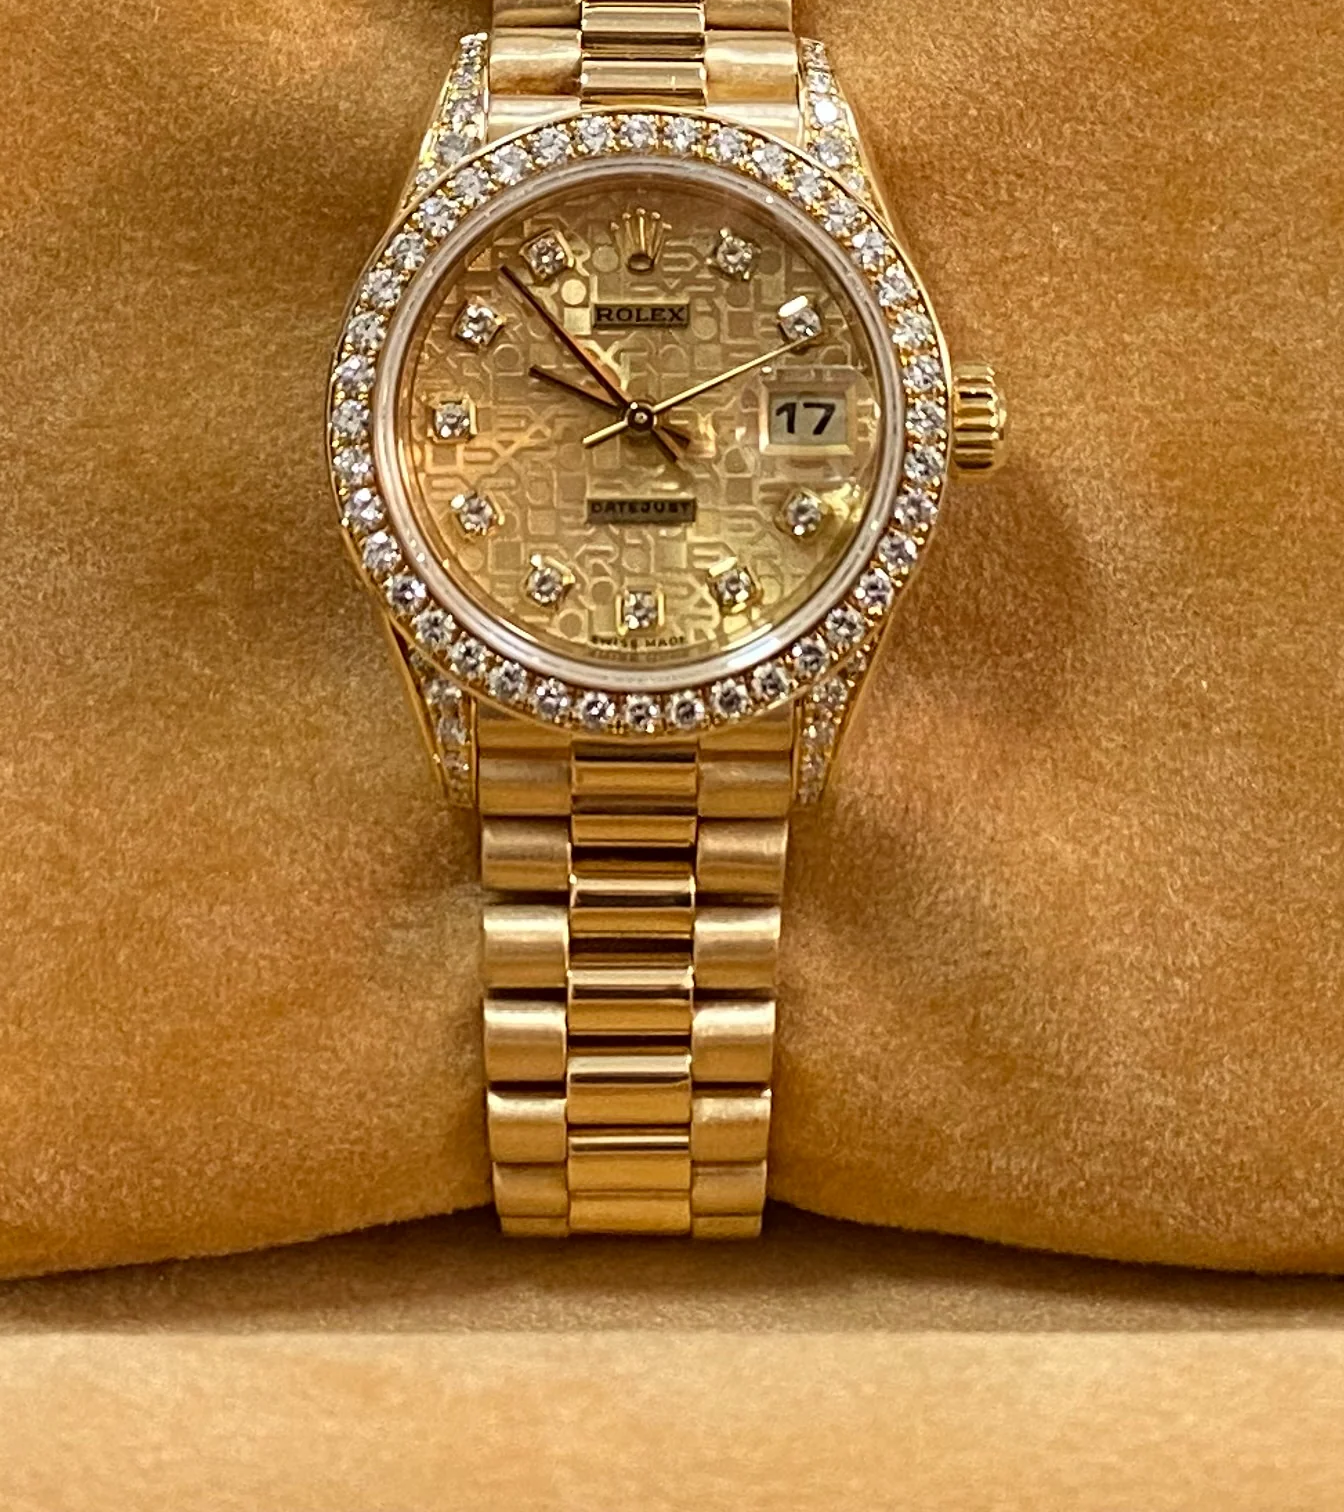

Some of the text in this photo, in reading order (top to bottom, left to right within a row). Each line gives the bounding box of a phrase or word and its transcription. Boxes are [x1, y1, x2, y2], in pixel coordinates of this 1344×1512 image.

[595, 306, 685, 323] ROLEX
[775, 401, 836, 436] 17
[590, 500, 692, 515] DATEJUST
